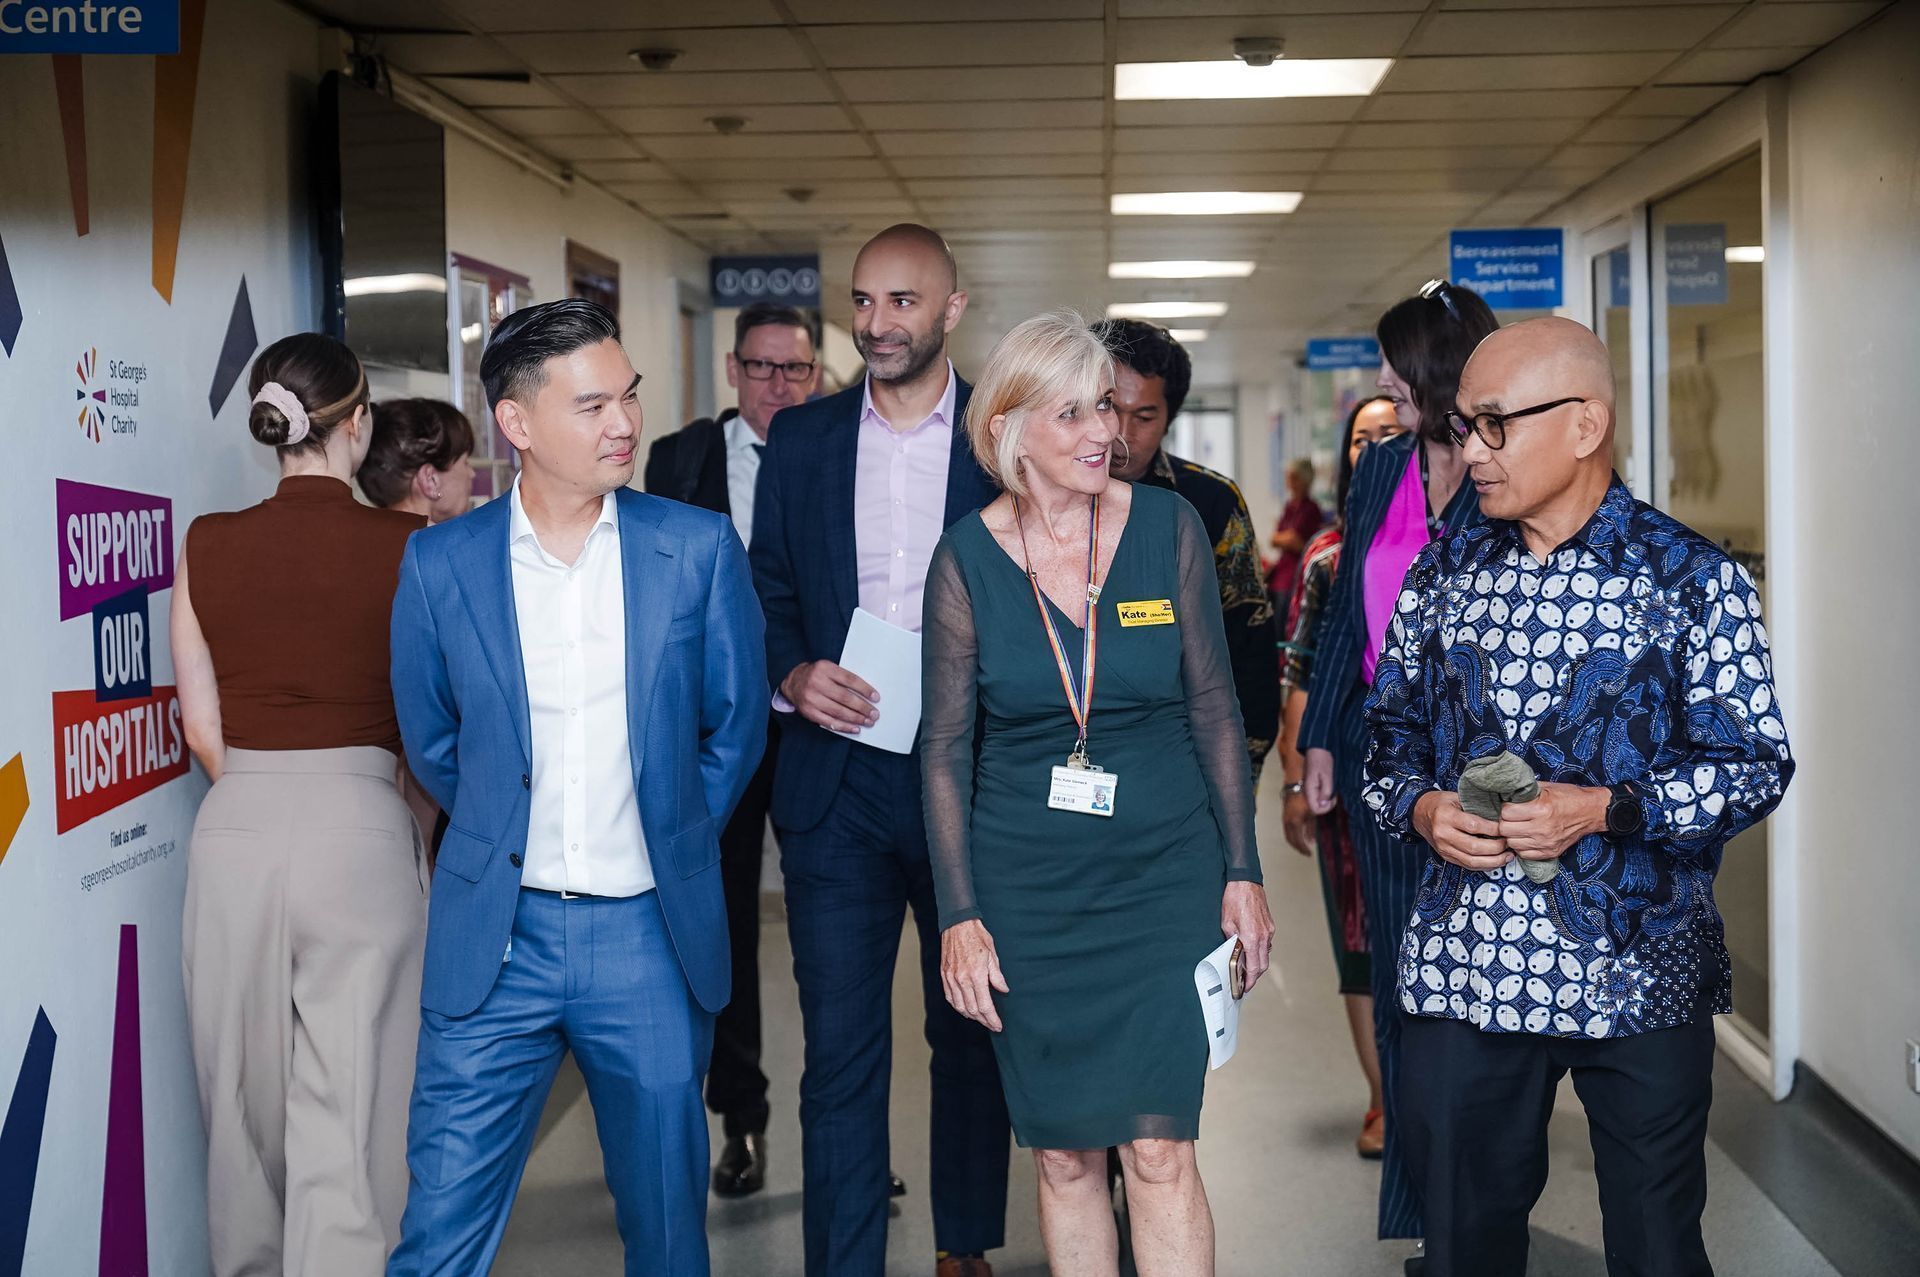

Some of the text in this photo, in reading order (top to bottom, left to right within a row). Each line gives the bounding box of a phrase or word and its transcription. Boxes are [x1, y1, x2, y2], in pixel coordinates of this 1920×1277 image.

[0, 0, 143, 34] Centre
[1454, 244, 1559, 258] Bereavement
[1475, 260, 1539, 276] Services
[109, 360, 147, 384] St George's
[110, 387, 139, 410] Hospital
[111, 415, 137, 438] Charity
[67, 508, 165, 588] SUPPORT
[1121, 610, 1147, 619] Kate
[101, 611, 145, 689] OUR
[63, 696, 182, 800] HOSPITALS
[110, 822, 148, 848] Find us online:
[80, 838, 175, 892] stgeorgeshospitalcharity.org.uk
